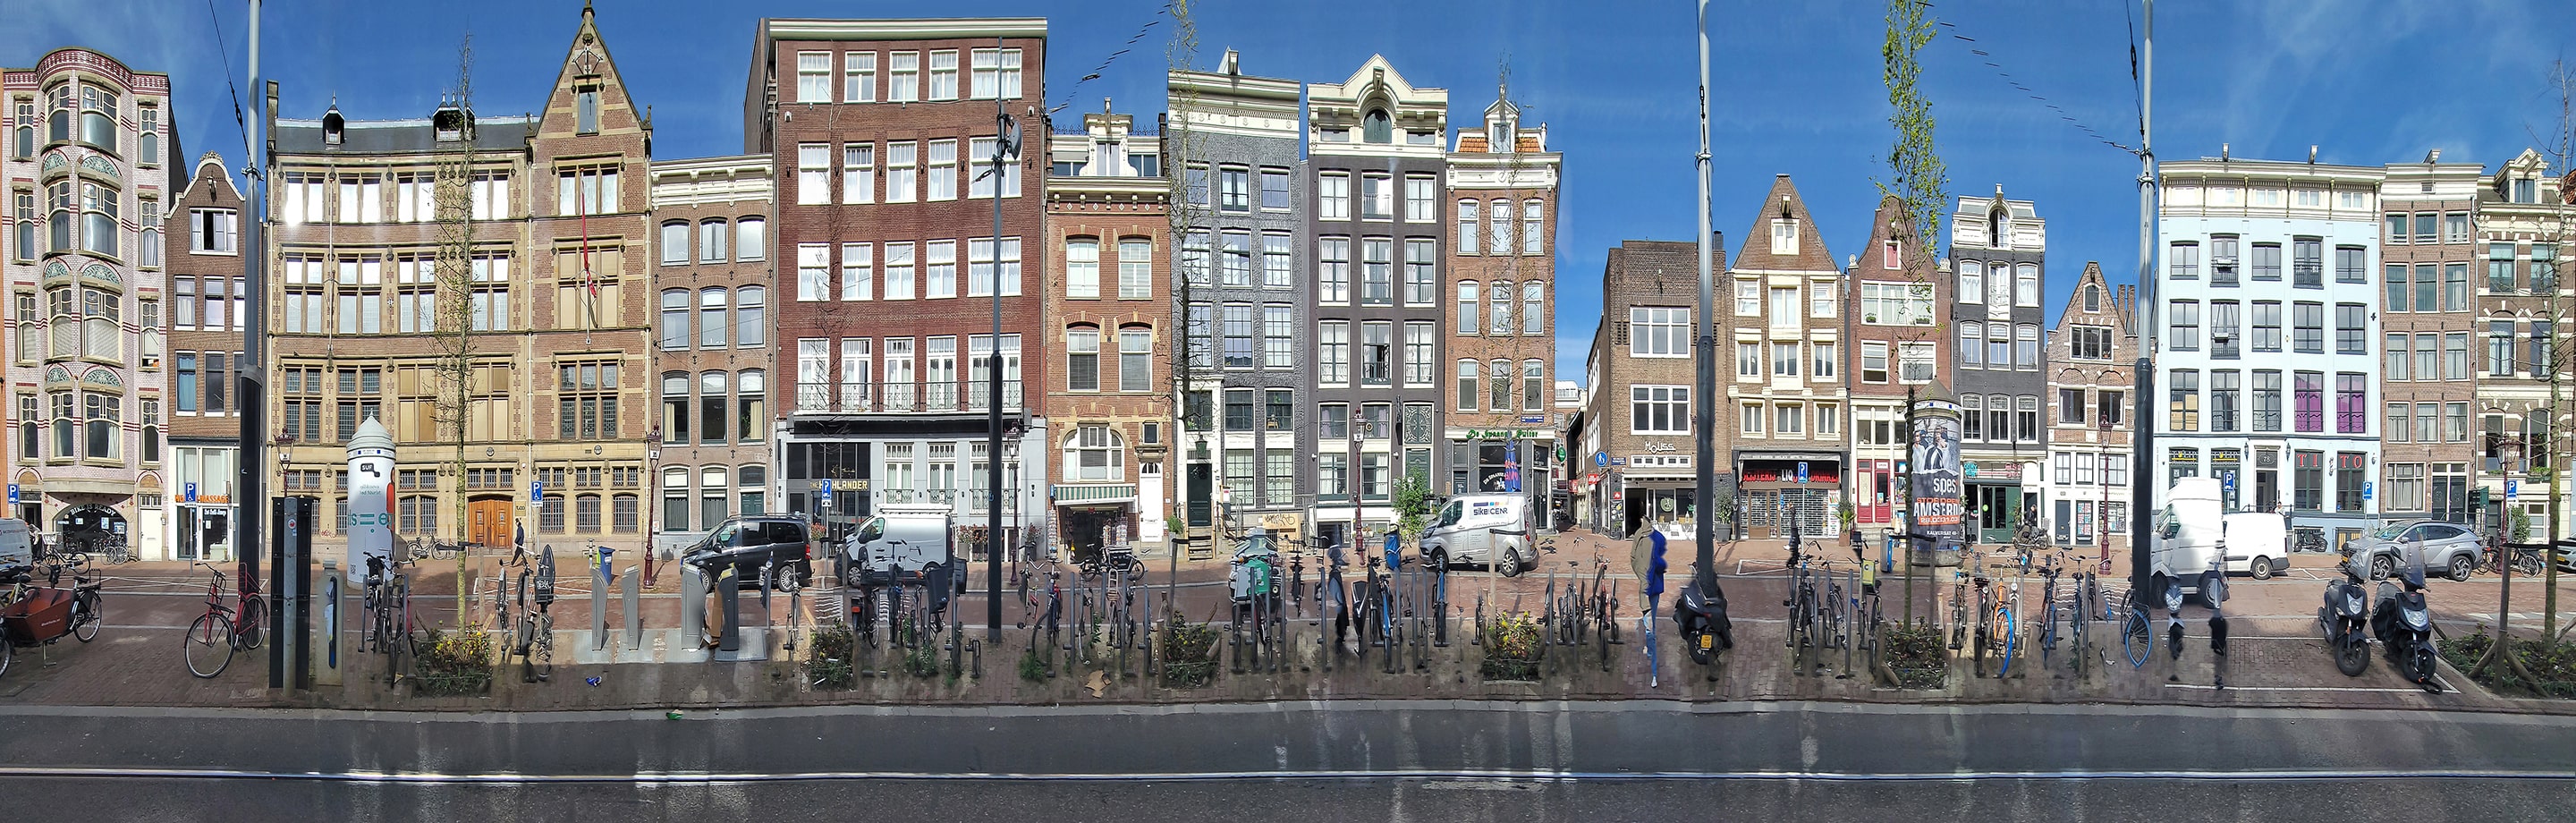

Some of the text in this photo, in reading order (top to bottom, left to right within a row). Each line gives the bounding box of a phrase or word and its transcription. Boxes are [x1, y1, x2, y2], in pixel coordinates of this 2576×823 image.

[2225, 474, 2233, 484] P
[9, 486, 16, 496] P
[187, 484, 194, 494] P
[533, 483, 540, 493] P
[2509, 481, 2515, 491] P
